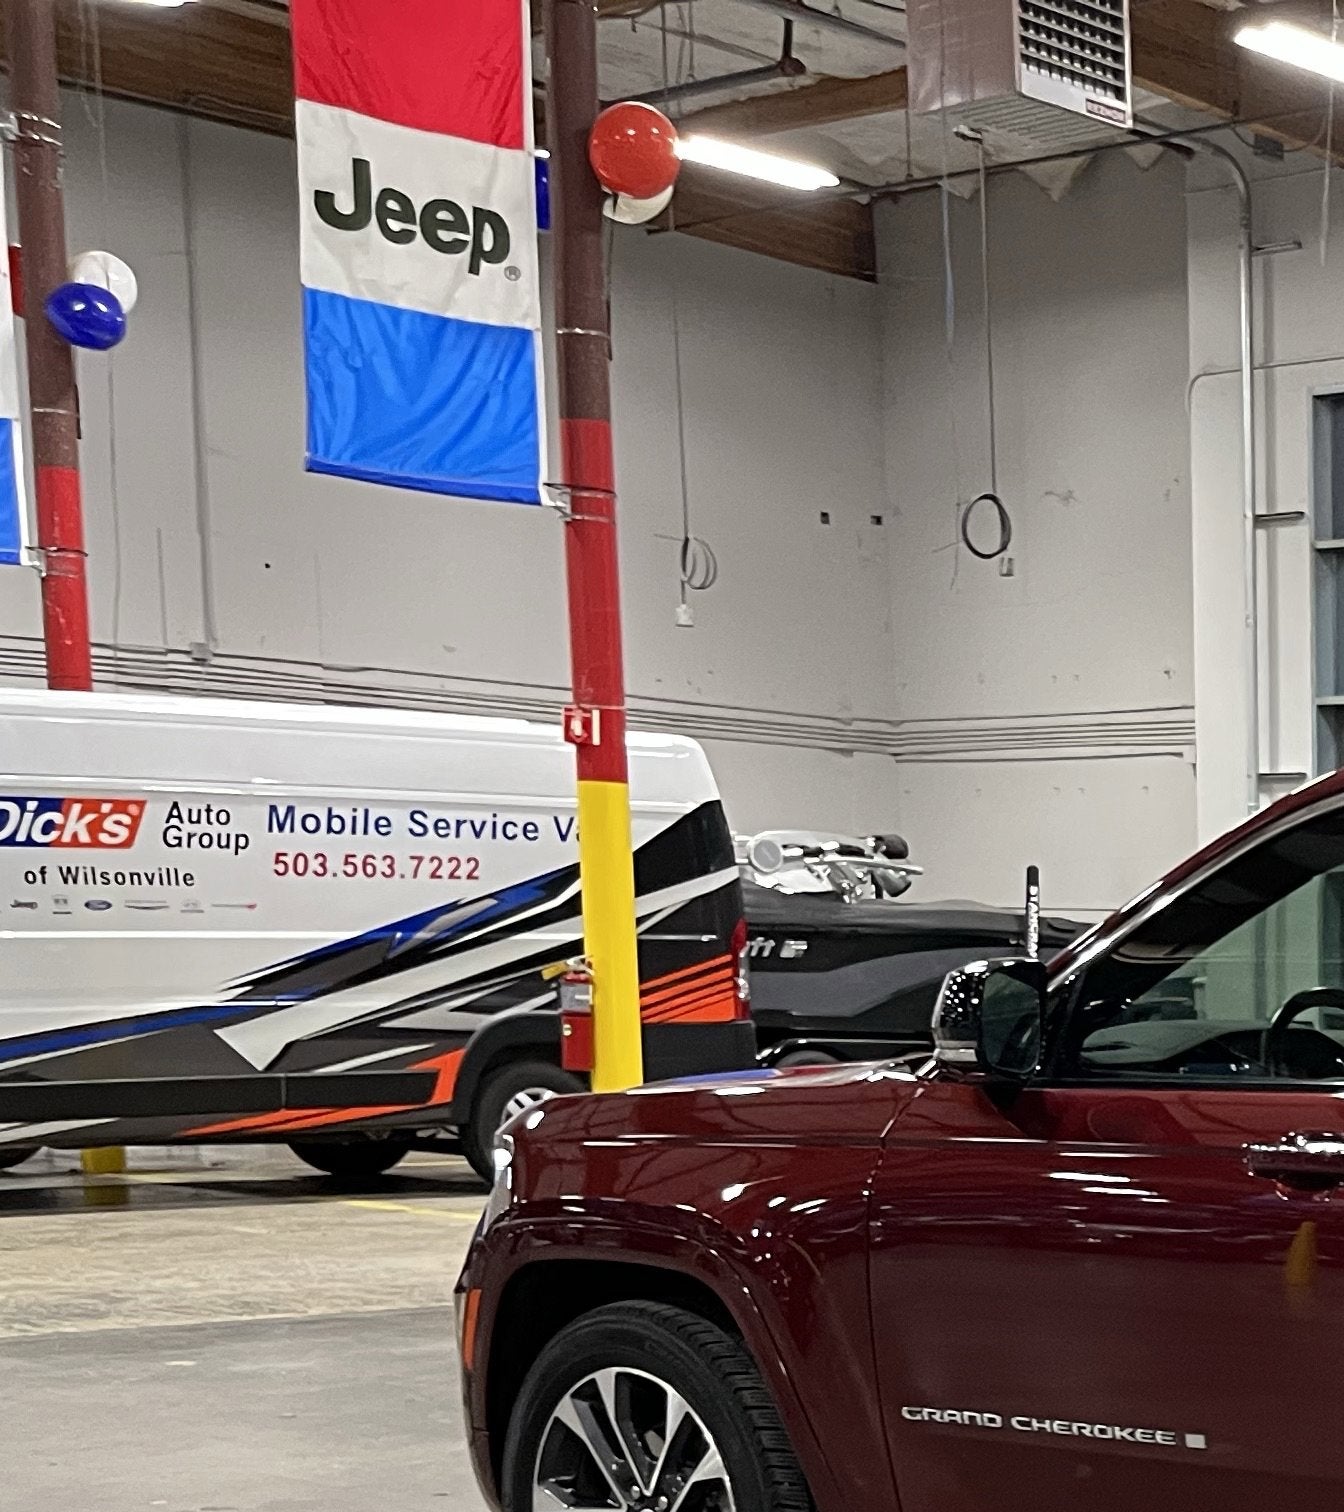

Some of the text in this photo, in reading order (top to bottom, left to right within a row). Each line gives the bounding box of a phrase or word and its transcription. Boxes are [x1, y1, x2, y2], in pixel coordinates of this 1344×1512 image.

[314, 157, 511, 276] Jeep
[165, 801, 231, 826] Auto
[267, 805, 580, 842] Mobile Service V
[162, 825, 249, 855] Group
[24, 866, 195, 887] of Wilsonville
[273, 852, 481, 880] 503.563.7222
[901, 1405, 1003, 1428] GRAND
[1010, 1415, 1176, 1446] CHEROKEE
